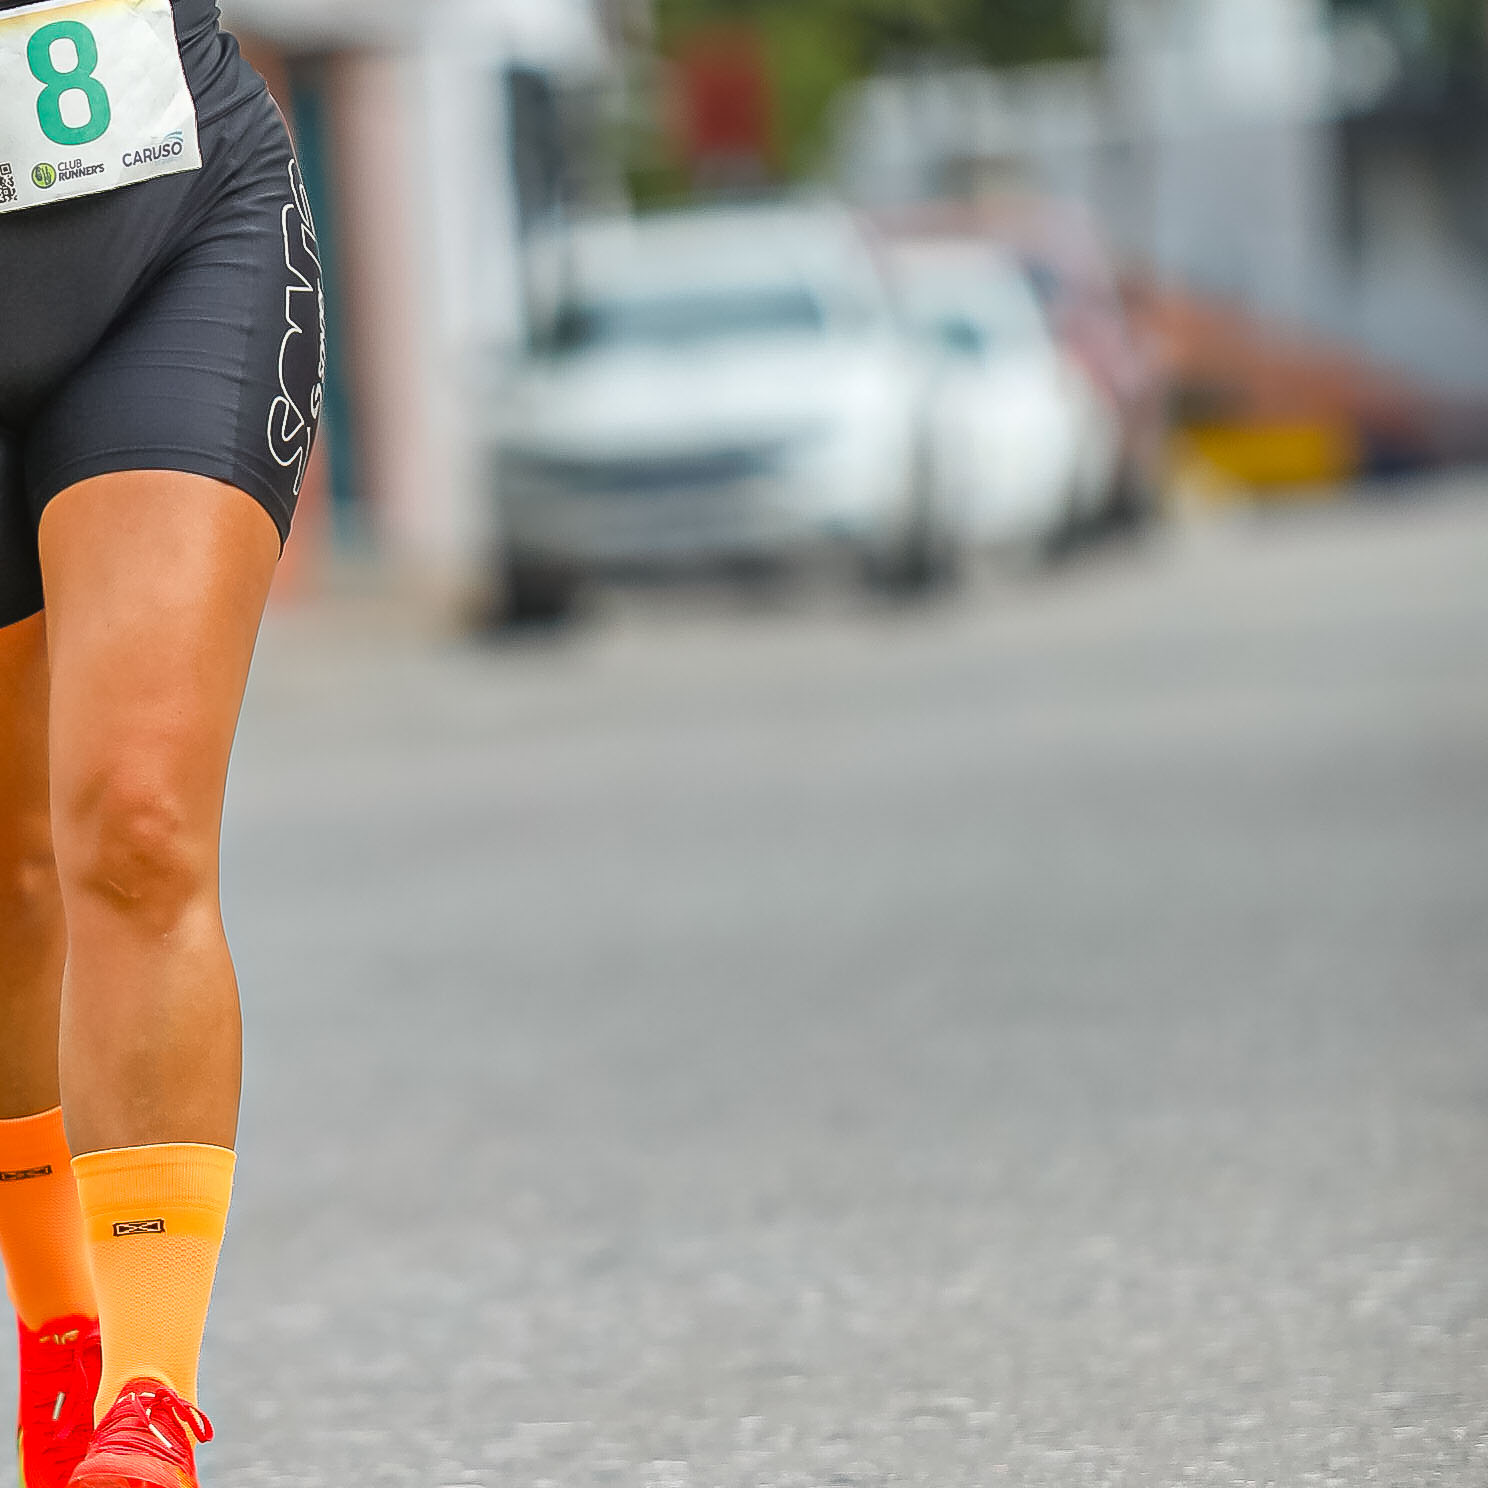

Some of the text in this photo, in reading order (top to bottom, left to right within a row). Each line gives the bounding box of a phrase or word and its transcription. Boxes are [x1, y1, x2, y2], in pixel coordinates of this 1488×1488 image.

[26, 20, 112, 146] 8
[57, 158, 82, 172] CLUB
[122, 141, 183, 168] CARUSO
